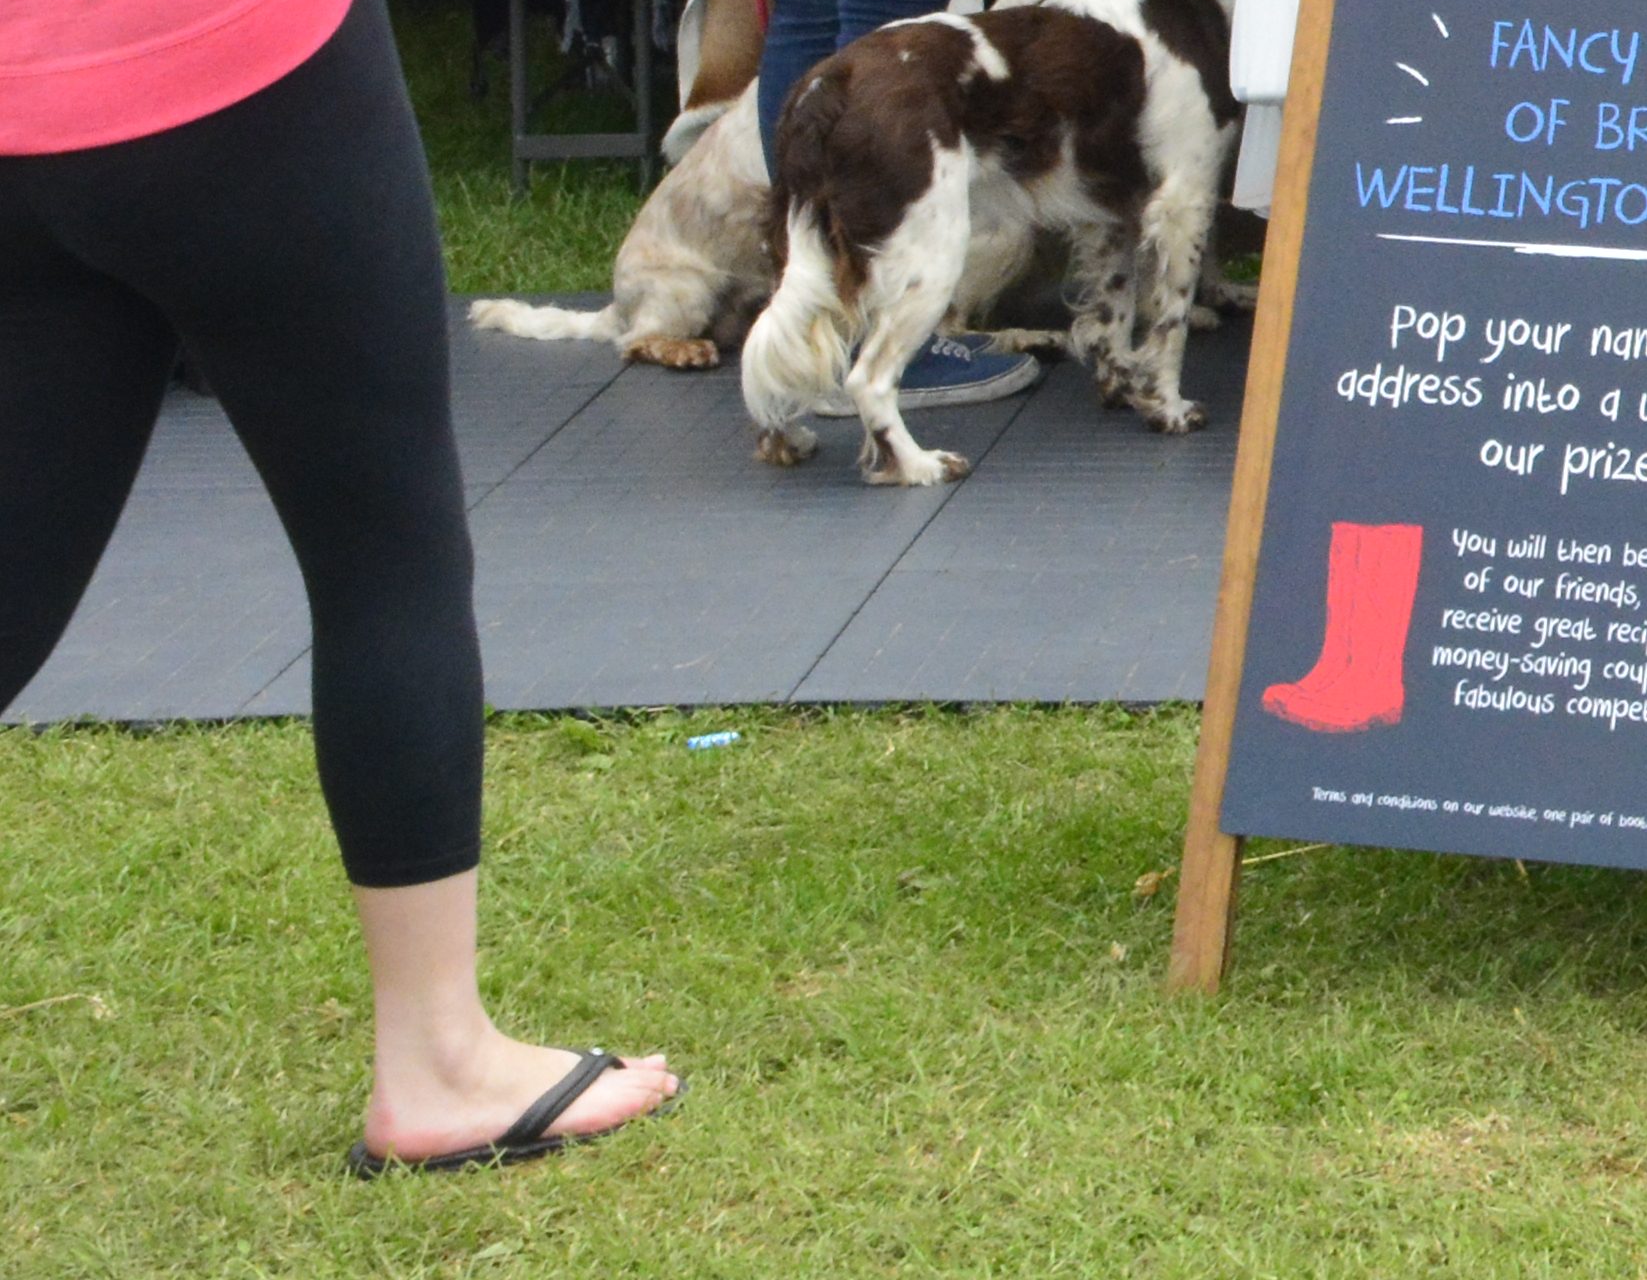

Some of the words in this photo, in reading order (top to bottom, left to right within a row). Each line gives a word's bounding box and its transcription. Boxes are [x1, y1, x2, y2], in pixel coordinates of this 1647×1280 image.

[1490, 17, 1640, 86] FANCY
[1505, 98, 1571, 146] OF
[1390, 304, 1466, 363] Pop
[1479, 318, 1572, 364] your
[1337, 362, 1483, 409] address
[1503, 372, 1581, 414] into
[1600, 388, 1621, 422] a
[1480, 439, 1545, 476] our
[1452, 528, 1497, 558] You
[1507, 534, 1547, 559] will
[1557, 539, 1612, 565] then
[1463, 566, 1493, 593] of
[1503, 574, 1545, 599] our
[1555, 572, 1641, 610] friends,
[1441, 607, 1523, 634] receive
[1530, 616, 1597, 649] great
[1431, 643, 1593, 692] money-saving
[1454, 678, 1555, 715] fabulous
[1312, 786, 1346, 804] Terms
[1352, 791, 1373, 808] and
[1376, 794, 1438, 811] conditions
[1443, 800, 1459, 812] on
[1464, 802, 1484, 815] our
[1488, 803, 1538, 821] website,
[1543, 809, 1566, 822] one
[1570, 809, 1593, 828] pair
[1600, 810, 1613, 825] of
